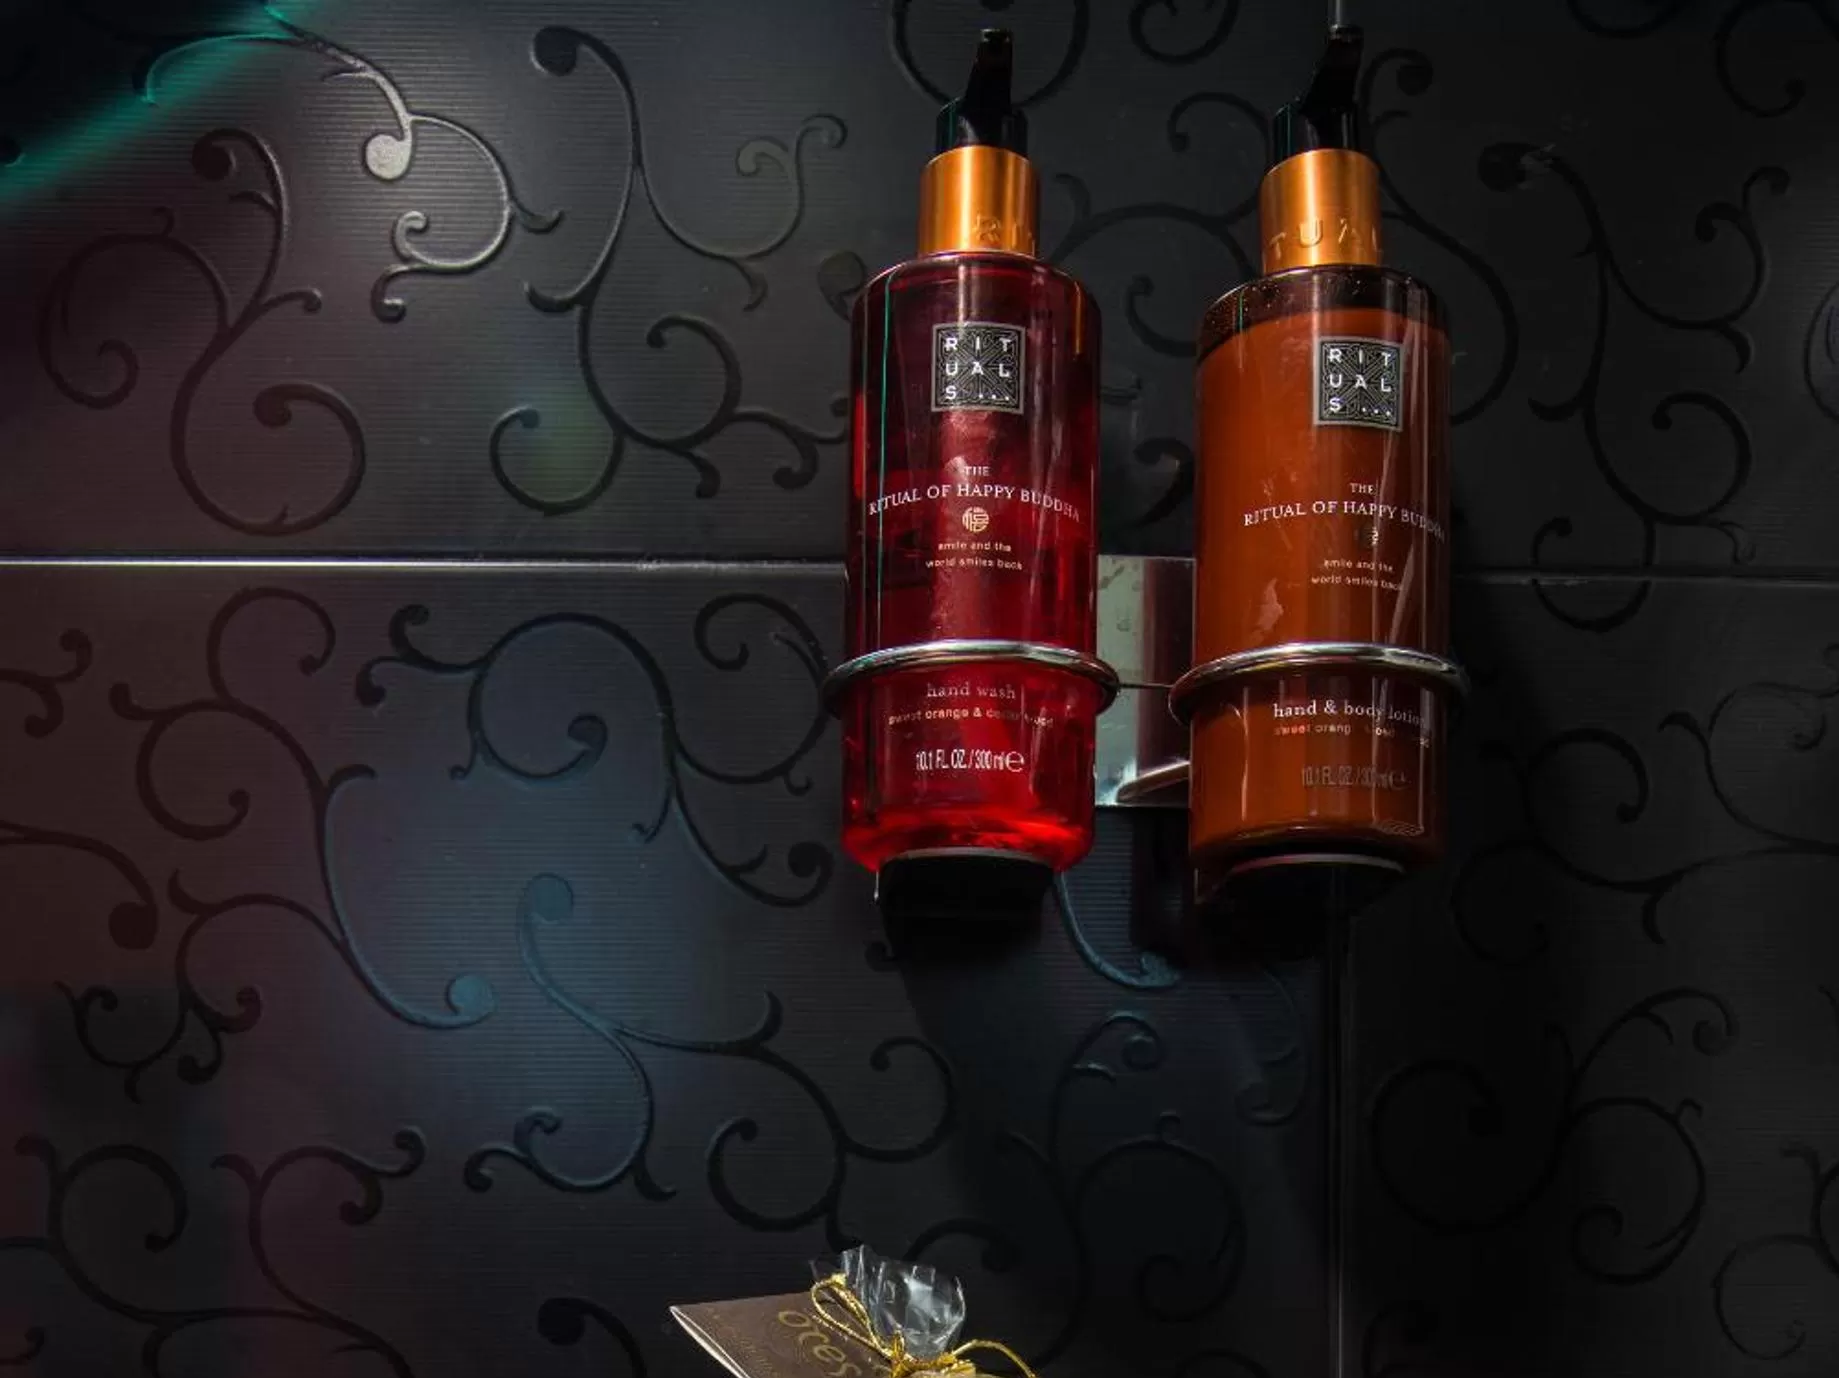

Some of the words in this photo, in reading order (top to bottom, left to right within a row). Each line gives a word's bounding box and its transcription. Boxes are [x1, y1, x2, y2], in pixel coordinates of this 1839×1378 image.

[963, 465, 990, 477] THE
[1349, 483, 1375, 494] THE
[868, 488, 922, 515] RITUAL
[927, 485, 951, 499] OF
[957, 484, 1016, 500] HAPPY
[1020, 491, 1080, 522] BUDDHA
[1244, 503, 1306, 526] RITUAL
[1312, 501, 1338, 514] OF
[1343, 501, 1398, 520] HAPPY
[971, 540, 991, 551] and
[995, 541, 1011, 553] the
[925, 558, 955, 569] world
[997, 557, 1023, 571] back
[1356, 560, 1375, 571] and
[927, 682, 970, 698] hand
[976, 683, 1016, 700] wash
[925, 708, 969, 720] orange
[973, 706, 982, 718] &
[1273, 700, 1317, 718] hand
[1323, 700, 1338, 715] &
[1344, 700, 1384, 723] body
[1315, 723, 1352, 736] orang
